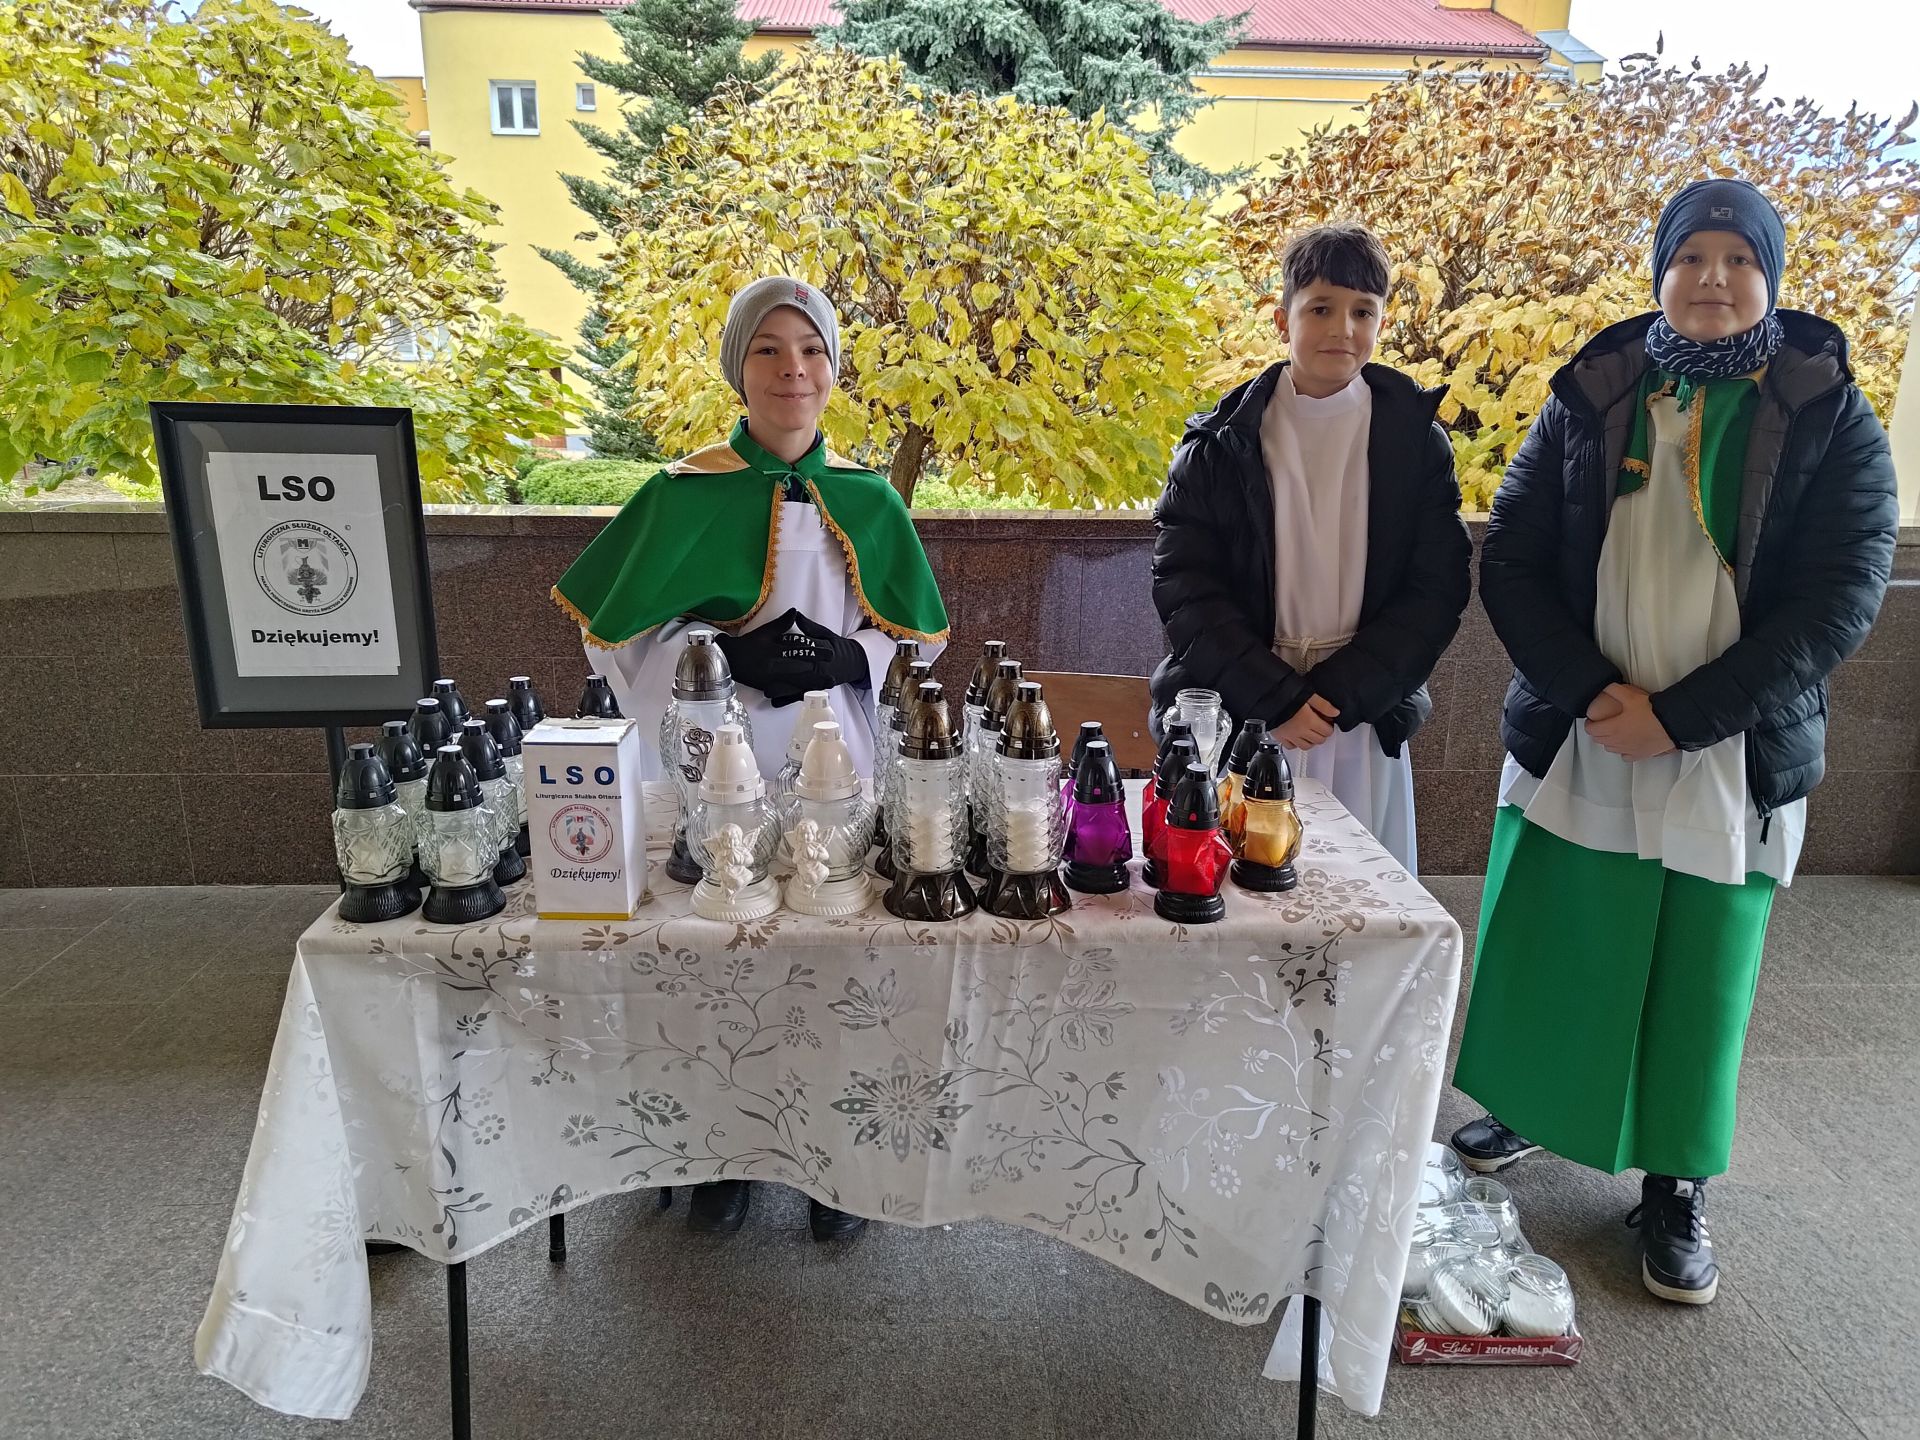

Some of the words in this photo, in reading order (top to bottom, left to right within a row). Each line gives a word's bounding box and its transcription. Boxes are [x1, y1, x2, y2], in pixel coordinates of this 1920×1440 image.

[257, 475, 335, 502] LSO
[257, 524, 290, 559] LITURGICZNA
[291, 522, 321, 533] SŁUŻBA
[323, 529, 349, 557] OŁTARZA
[251, 629, 379, 647] Dziękujemy!
[782, 634, 816, 648] KIPSTA
[782, 648, 816, 658] KIPSTA
[535, 792, 573, 800] Liturgiczna
[551, 867, 621, 883] Dziękujemy!
